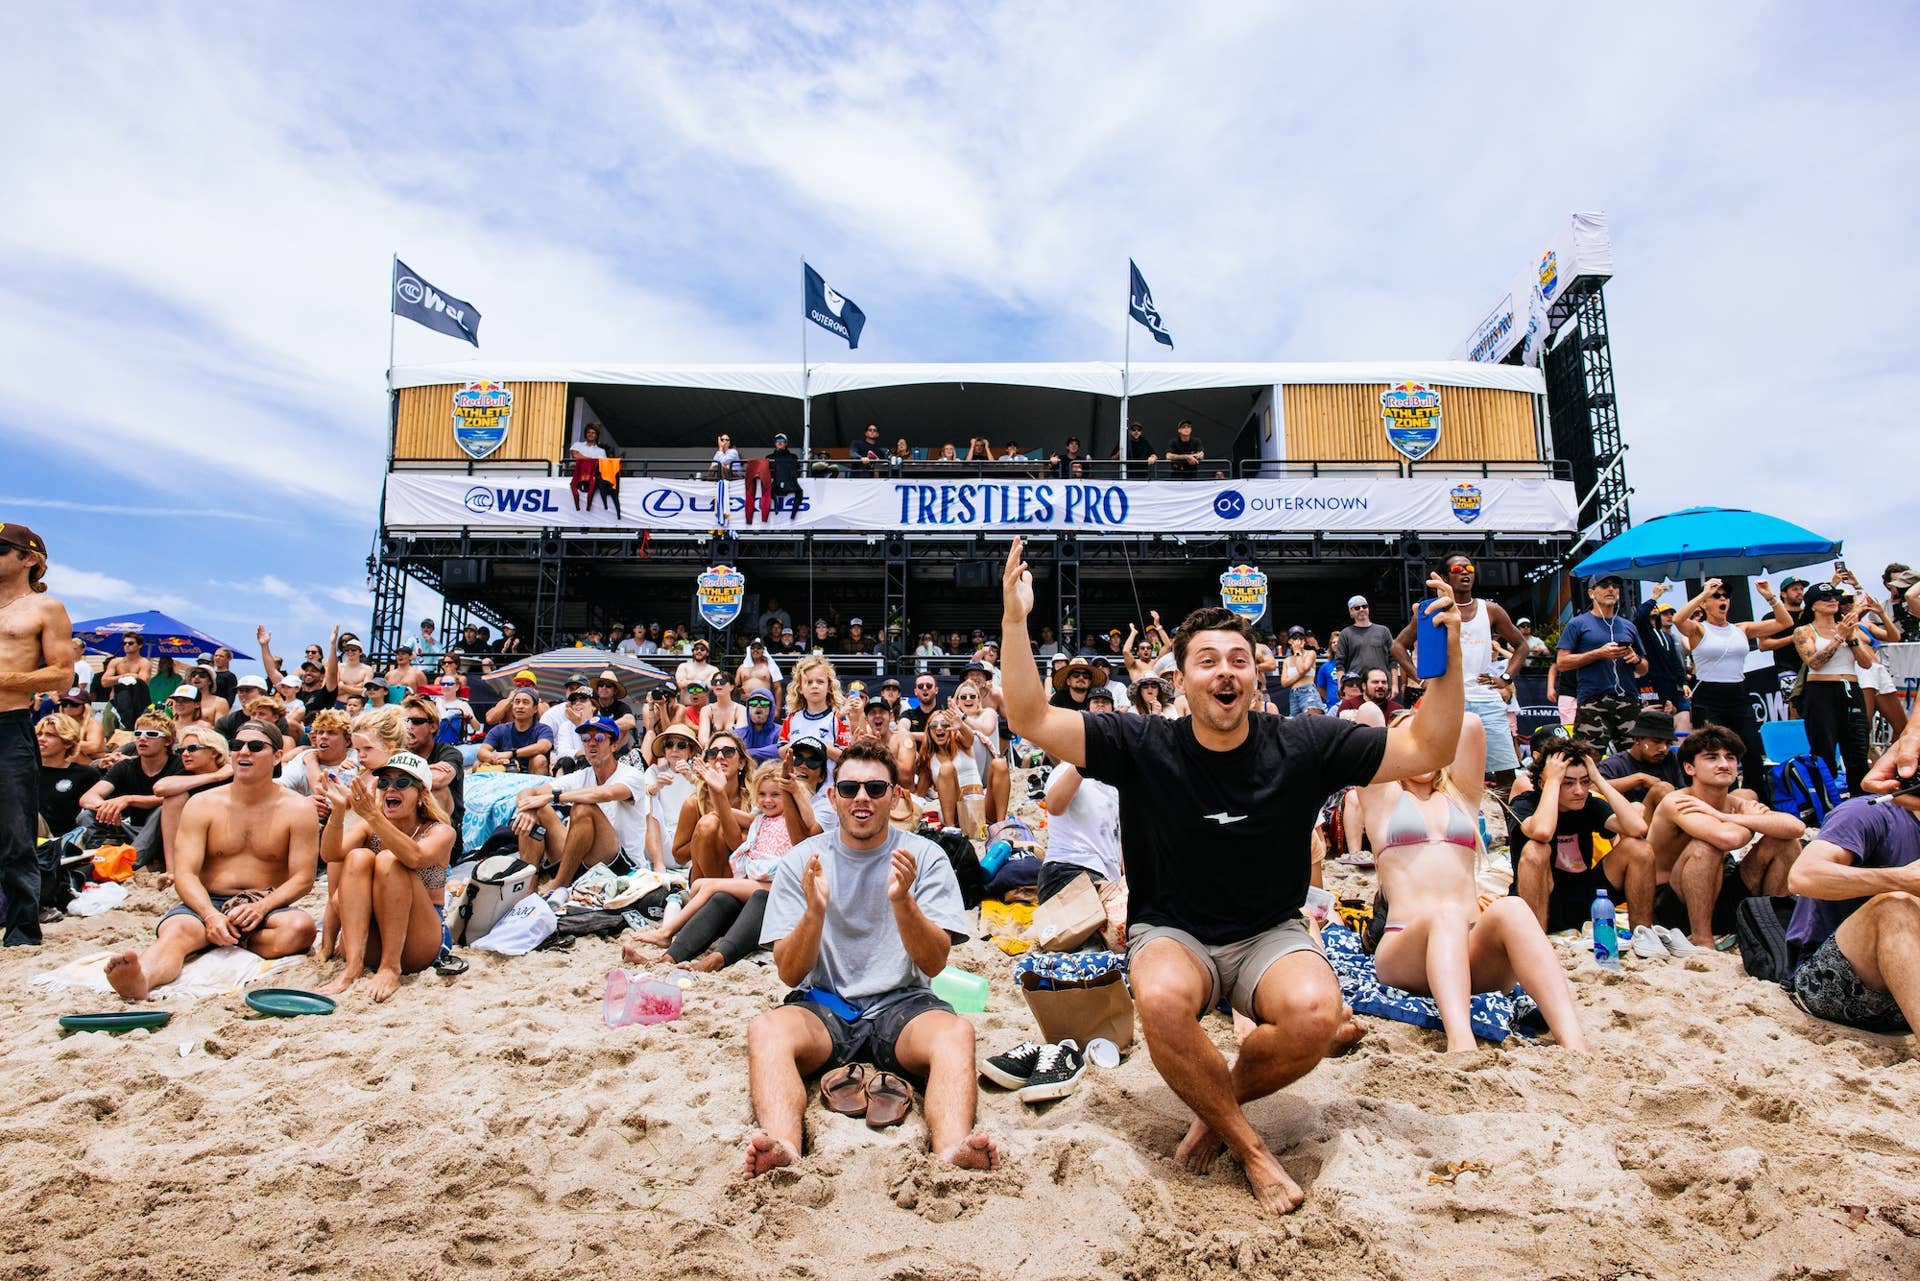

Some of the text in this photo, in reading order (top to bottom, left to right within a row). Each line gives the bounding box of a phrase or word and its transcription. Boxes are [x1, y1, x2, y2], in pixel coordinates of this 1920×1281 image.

[461, 394, 505, 406] Red Bull
[1388, 396, 1433, 406] Red Bull
[455, 406, 510, 418] ATHLETE
[1383, 406, 1440, 418] ATHLETE
[464, 417, 499, 427] ZONE
[1395, 418, 1430, 428] ZONE
[496, 489, 559, 513] WSL
[895, 484, 1130, 525] TRESTLES PRO
[699, 586, 743, 596] ATHLETE
[1222, 586, 1266, 595] ATHLETE
[707, 595, 734, 603] ZONE
[1231, 594, 1259, 603] ZONE
